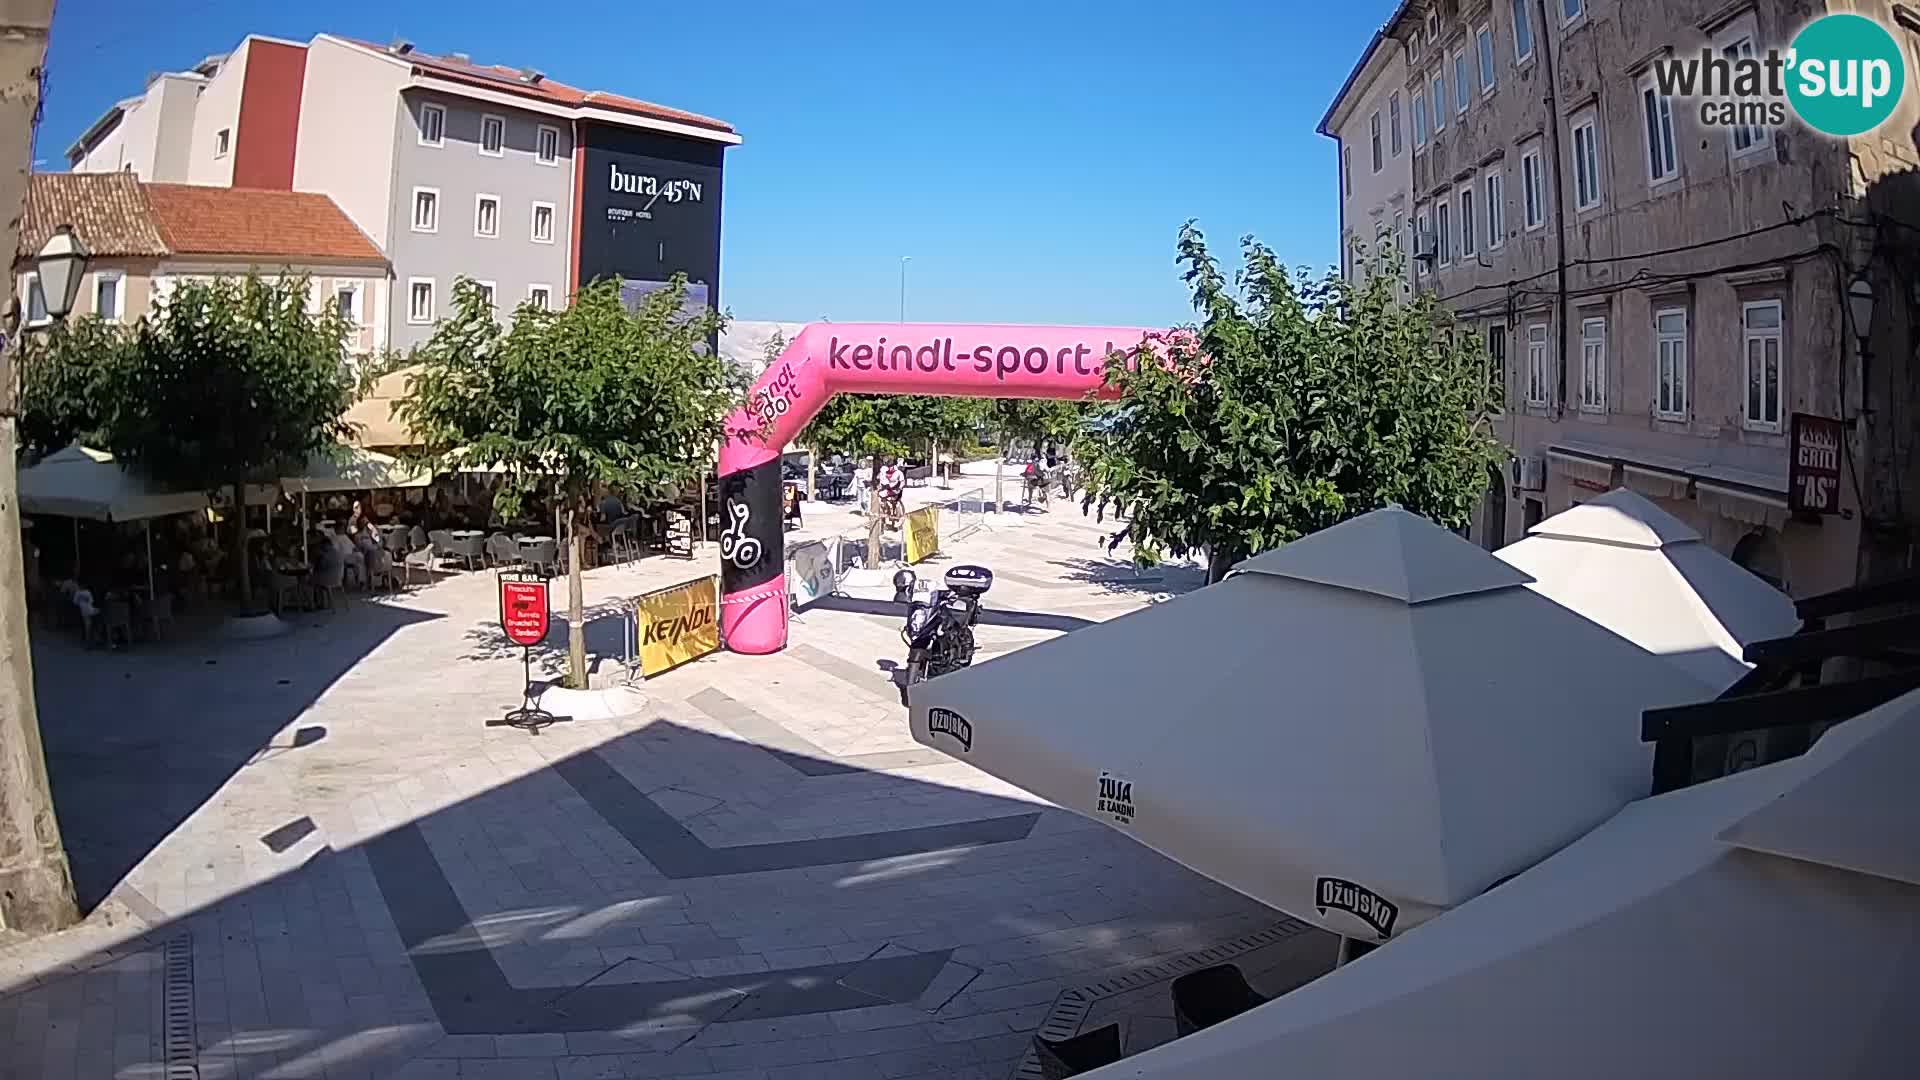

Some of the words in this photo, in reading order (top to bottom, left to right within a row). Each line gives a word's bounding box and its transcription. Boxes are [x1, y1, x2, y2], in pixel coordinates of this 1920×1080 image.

[610, 164, 657, 195] bura
[1799, 446, 1838, 470] GRILL
[521, 574, 538, 582] BAR
[642, 605, 712, 646] KEINDL
[1099, 771, 1132, 804] ŽUJA
[1322, 880, 1392, 929] Ožujsko
